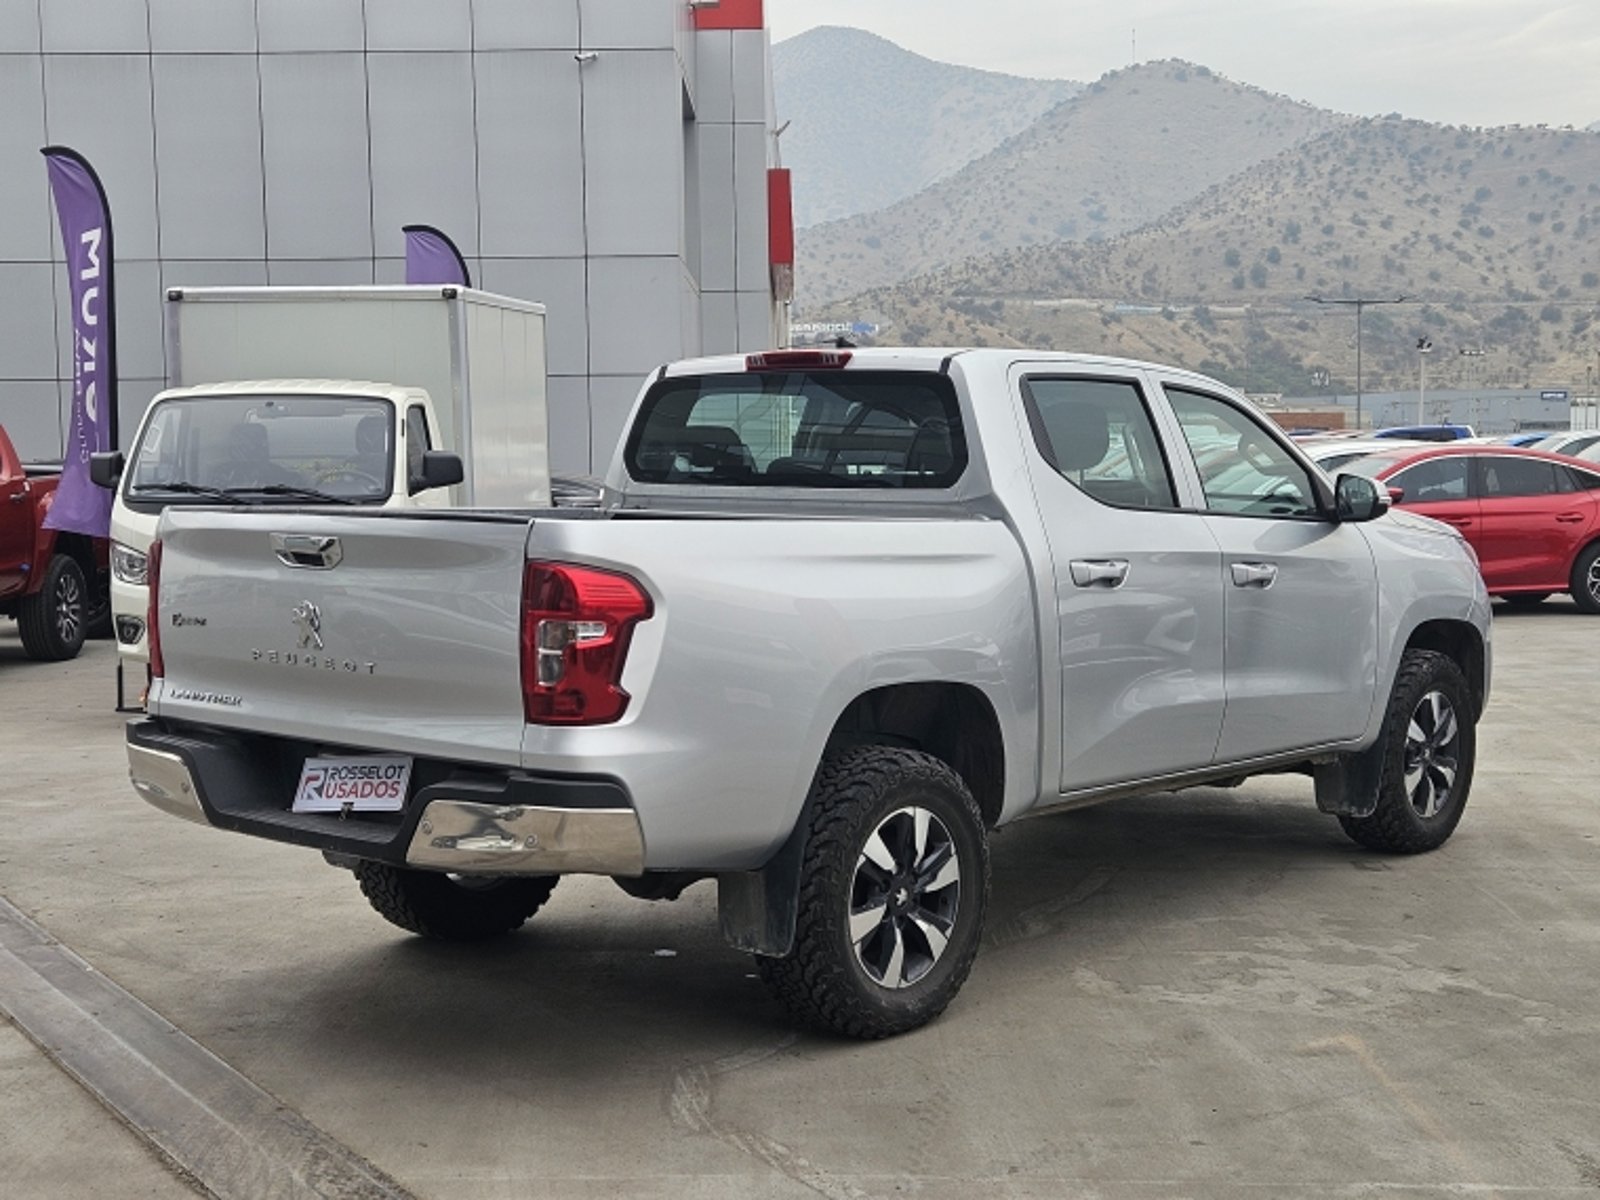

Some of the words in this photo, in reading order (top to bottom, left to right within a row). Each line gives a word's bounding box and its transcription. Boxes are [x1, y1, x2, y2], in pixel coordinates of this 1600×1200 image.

[251, 648, 376, 674] PEUGEOT
[328, 764, 405, 780] ROSSELOT
[325, 780, 401, 799] USADOS
